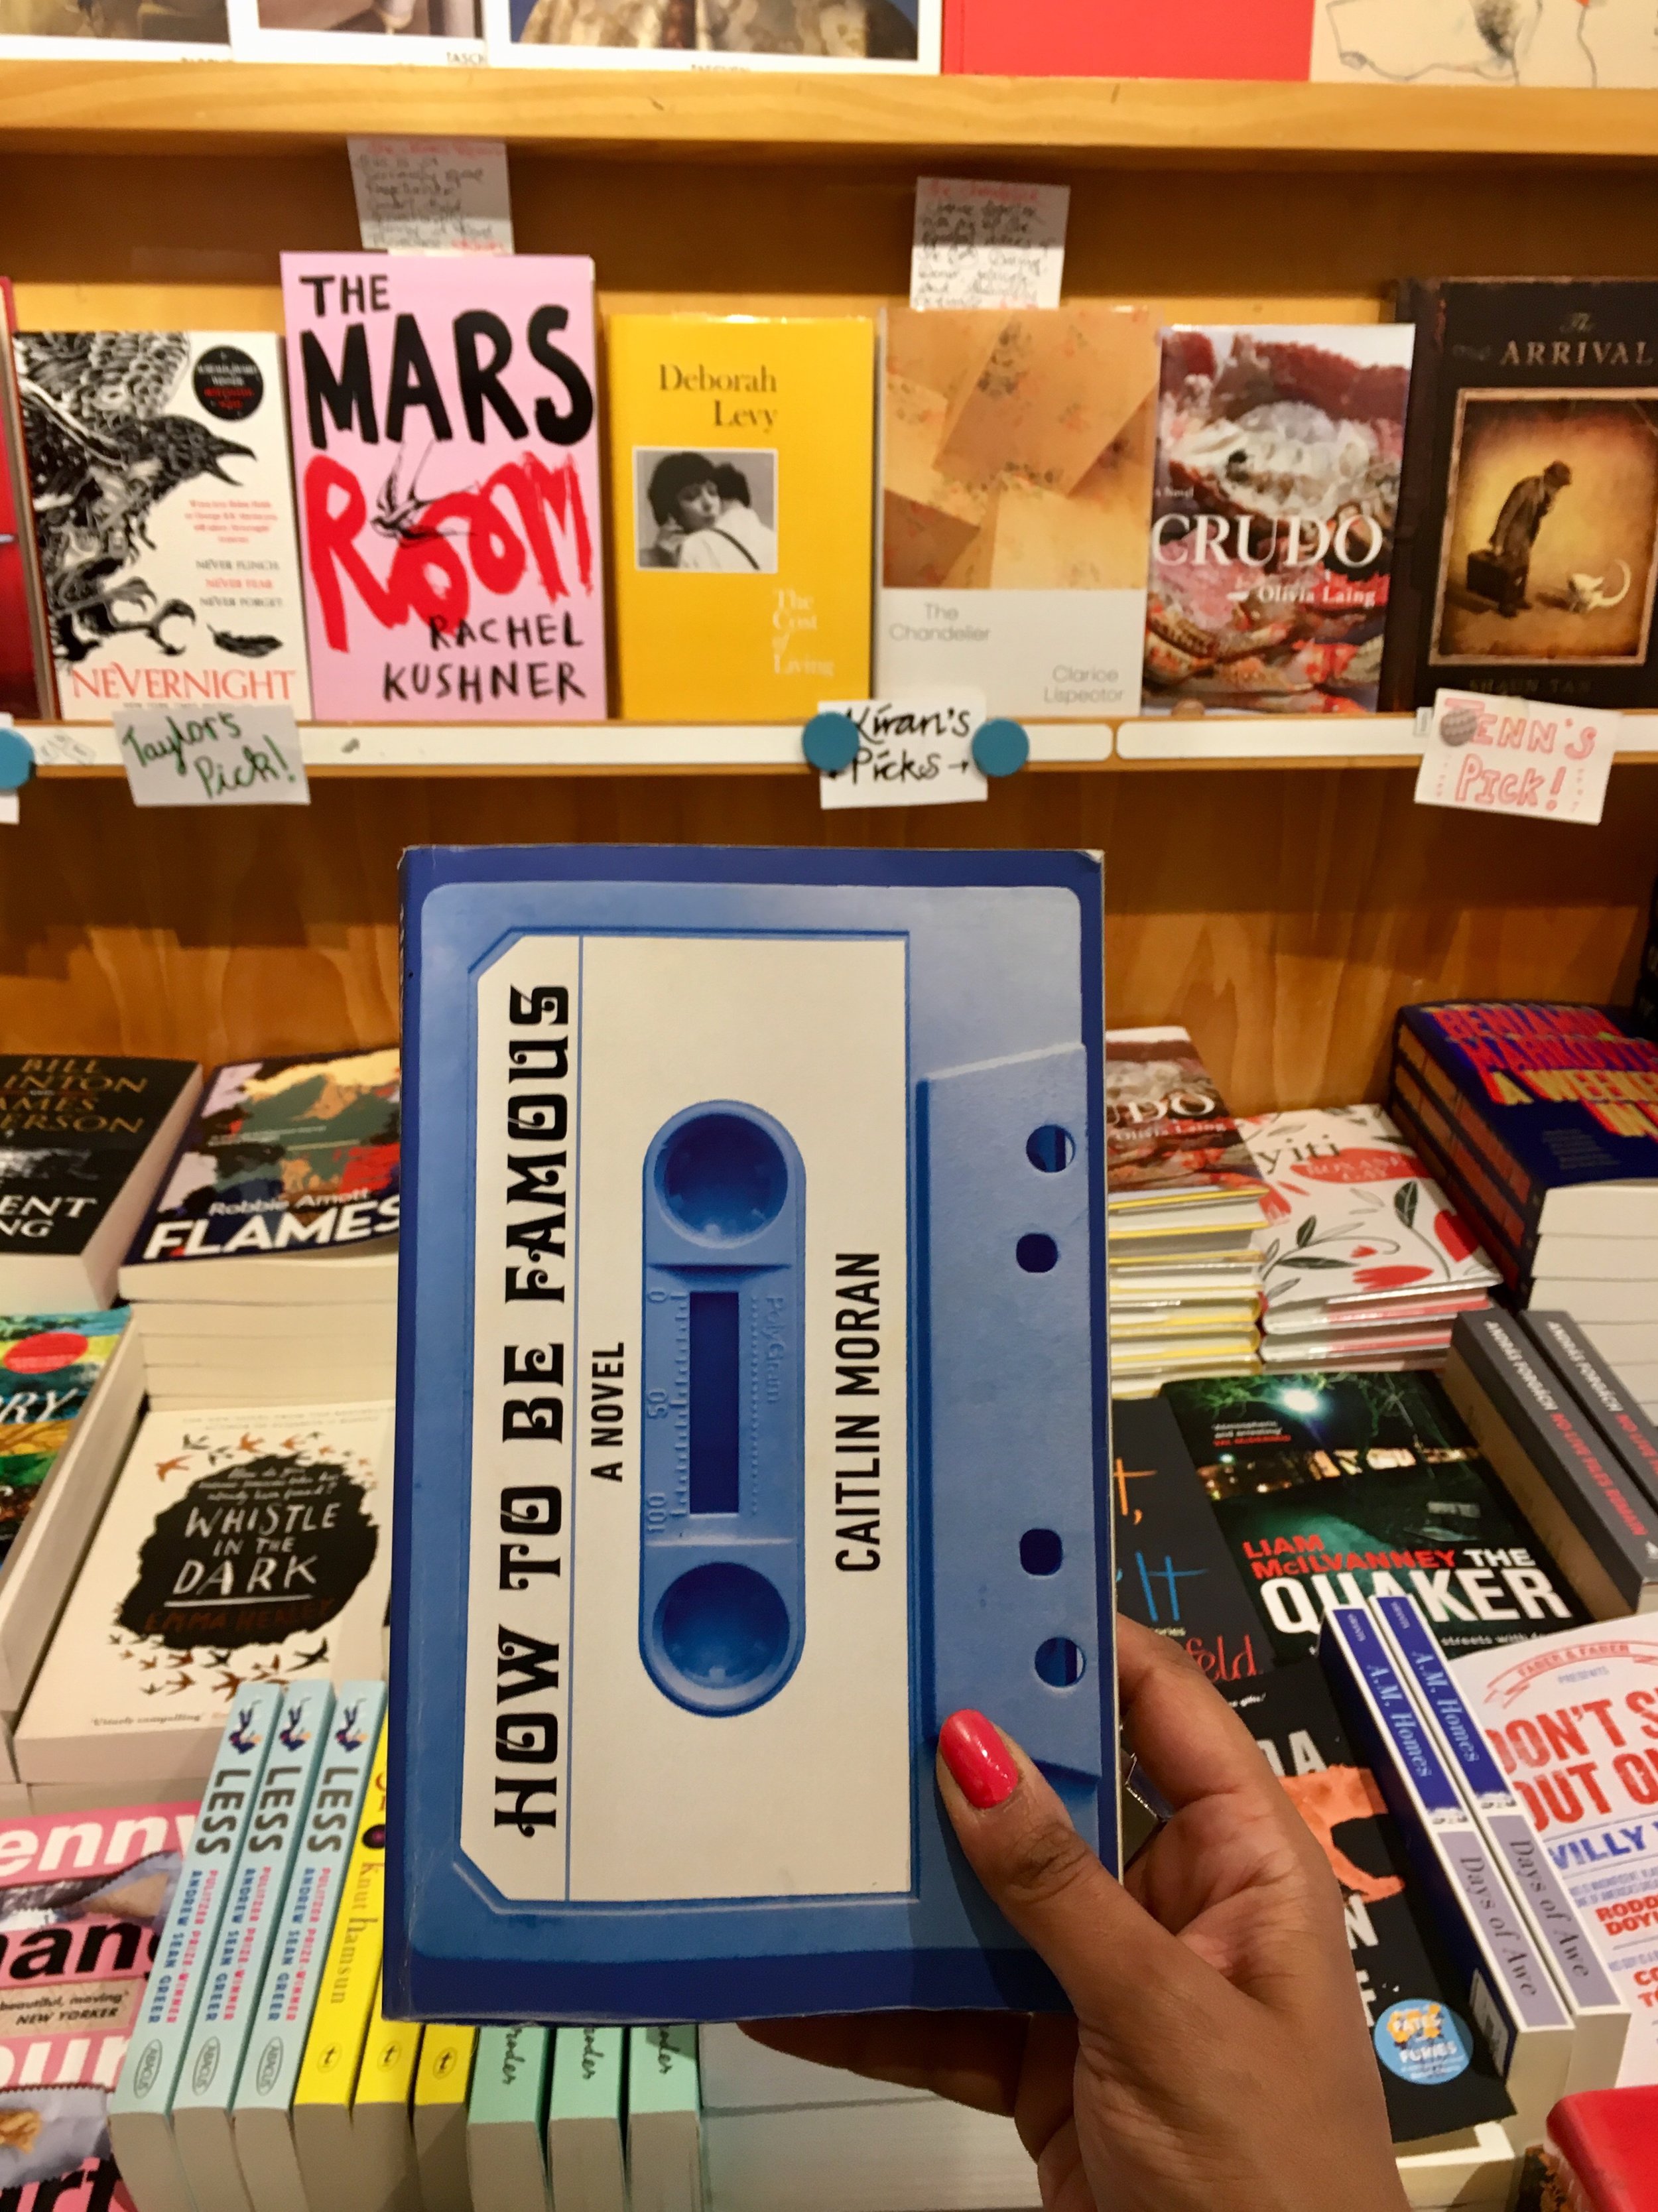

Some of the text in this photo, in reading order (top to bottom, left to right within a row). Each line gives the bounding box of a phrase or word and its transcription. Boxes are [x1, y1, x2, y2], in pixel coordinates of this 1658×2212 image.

[300, 275, 391, 317] THE
[1499, 340, 1653, 365] ARRIVAL
[300, 304, 594, 450] MARS
[659, 363, 777, 393] Deborah
[714, 399, 779, 432] Levy
[304, 450, 593, 653] ROOM
[1151, 513, 1384, 568] CRUDO
[775, 589, 814, 612] The
[924, 603, 959, 621] The
[1258, 584, 1376, 608] Olivia Laing
[429, 611, 584, 651] RACHEL
[773, 609, 817, 631] Cost
[888, 623, 991, 642] Chandelier
[70, 661, 296, 700] NEVERNIGHT
[382, 659, 587, 705] KUSHNER
[773, 653, 835, 677] Living
[1051, 664, 1119, 684] Clarice
[1044, 686, 1124, 705] Lispector
[846, 702, 970, 744] Kiran's
[194, 734, 296, 800] Pick!
[851, 746, 942, 785] Picks
[1257, 1134, 1340, 1175] yiti
[208, 1187, 369, 1216] Robbie Arnott
[143, 1194, 400, 1260] FLAMES
[760, 1295, 786, 1404] PolyGram
[0, 1387, 79, 1424] RY
[493, 984, 569, 1837] HOW TO BE FAMOUS
[590, 1342, 625, 1482] A NOVEL
[646, 1388, 668, 1419] 50
[834, 1252, 881, 1572] CAITLIN MORAN
[184, 1501, 341, 1538] WHISTLE
[646, 1492, 667, 1531] 100
[213, 1536, 296, 1557] IN THE
[1242, 1534, 1324, 1559] LIAM
[1250, 1549, 1537, 1579] McILVANNEY THE
[172, 1554, 318, 1595] DARK
[1260, 1569, 1572, 1634] QUAKER
[1440, 1635, 1493, 1646] streets
[1366, 1664, 1433, 1777] A.M. Homes
[1411, 1651, 1480, 1762] A.M. Homes
[195, 1769, 251, 1854] LESS
[248, 1766, 302, 1852] LESS
[307, 1767, 359, 1852] LESS
[1460, 1857, 1537, 1996] Days of Awe
[1509, 1840, 1589, 1977] Days of Awe
[0, 1922, 159, 1981] an
[149, 1870, 202, 2024] ANDREW SEAN GREER
[166, 1869, 219, 2024] PULITZER PRIZE-WINNER
[206, 1868, 256, 2021] ANDREW SEAN GREER
[223, 1866, 272, 2021] PULITZER PRIZE-WINNER
[268, 1867, 315, 2021] ANDREW SEAN GREER
[285, 1866, 331, 2021] PULITZER PRIZE-WINNER
[16, 2007, 118, 2025] NEW YORKER
